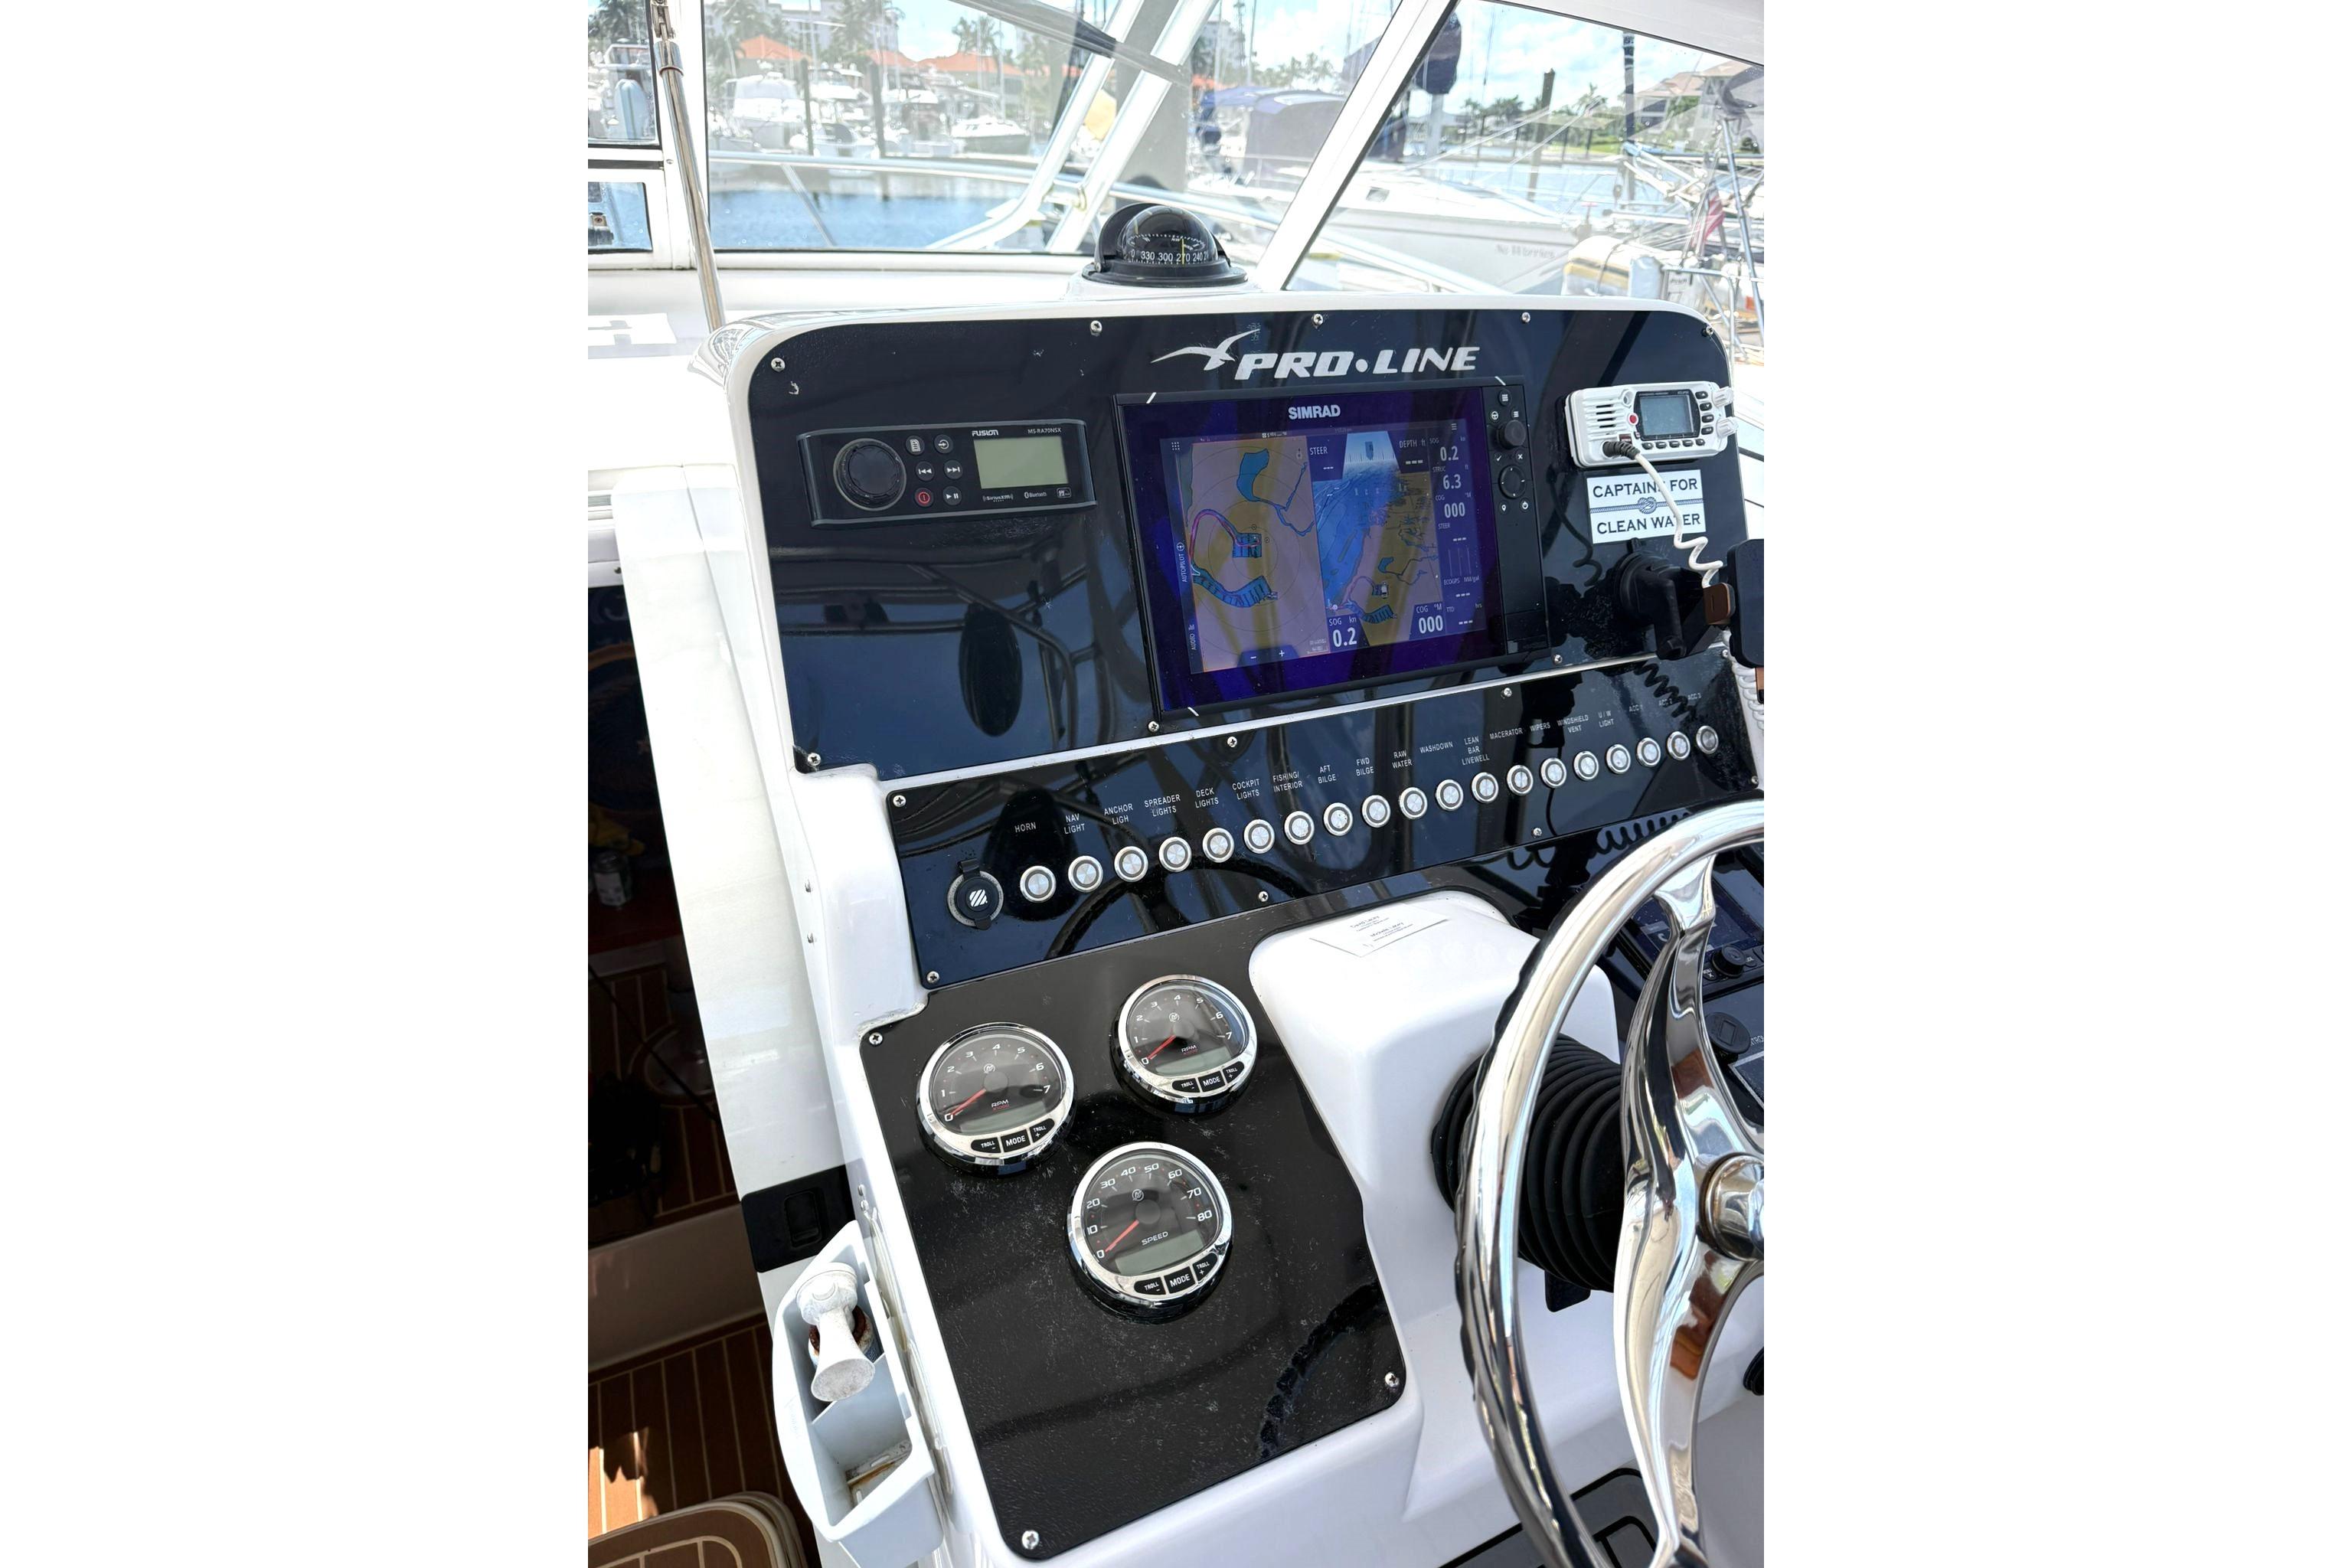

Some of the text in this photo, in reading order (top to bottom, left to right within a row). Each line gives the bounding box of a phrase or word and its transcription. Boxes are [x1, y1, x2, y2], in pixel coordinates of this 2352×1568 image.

[1141, 251, 1155, 260] 330
[1158, 253, 1173, 261] 300
[1193, 252, 1203, 262] 240
[1288, 404, 1341, 420] SIMRAD
[1399, 439, 1417, 448] DEPTH
[1310, 447, 1328, 456] STEER
[1440, 446, 1459, 461] 0.2
[1443, 474, 1462, 489] 6.3
[1593, 479, 1697, 498] CAPTAIN FOR
[1444, 502, 1465, 518] 000
[1597, 513, 1700, 534] CLEAN WAER
[1179, 554, 1187, 583] AUTOPILOT
[1416, 605, 1429, 613] COG
[1329, 615, 1357, 626] SOG kn
[1419, 615, 1443, 634] 000
[1332, 627, 1357, 648] 0.2
[1557, 714, 1589, 727] WINDSHIELD
[1599, 718, 1614, 728] LIGHT
[1530, 722, 1550, 732] WIPERS
[1568, 725, 1582, 733] VENT
[1490, 727, 1523, 740] MACERATOR
[1464, 736, 1479, 746] LEAN
[1419, 741, 1453, 754] WASHDOWN
[1468, 746, 1480, 754] BAR
[1393, 750, 1407, 759] RAW
[1462, 753, 1490, 766] LIVEWELL
[1356, 757, 1370, 766] FWD
[1392, 759, 1412, 769] WATER
[1319, 765, 1331, 773] AFT
[1356, 766, 1374, 776] BILGE
[1272, 771, 1299, 782] FISHING/
[1318, 774, 1336, 784] BILGE
[1232, 779, 1260, 791] COCKPIT
[1273, 780, 1303, 792] INTERIOR
[1196, 787, 1214, 798] DECK
[1236, 789, 1260, 800] LIGHTS
[1144, 794, 1181, 808] SPREADER
[1195, 797, 1219, 808] LIGHTS
[1104, 803, 1133, 815] ANCHOR
[1152, 805, 1177, 817] LIGHTS
[1065, 813, 1080, 823] NAV
[1014, 822, 1037, 833] HORN
[1063, 823, 1086, 835] LIGHT
[1226, 1031, 1233, 1040] 7
[1181, 1044, 1197, 1054] RPM
[1203, 1076, 1221, 1087] MODE
[1043, 1085, 1051, 1094] 7
[991, 1099, 1009, 1108] RPM
[1005, 1135, 1026, 1147] MODE
[1121, 1166, 1136, 1177] 40
[1145, 1163, 1159, 1173] 50
[1168, 1169, 1183, 1180] 60
[1100, 1178, 1116, 1188] 30
[1187, 1187, 1202, 1199] 70
[1086, 1198, 1100, 1210] 20
[1197, 1210, 1213, 1222] 80
[1087, 1225, 1098, 1236] 10
[1142, 1231, 1168, 1246] SPEED
[1096, 1250, 1105, 1259] 0
[1196, 1261, 1210, 1269] TROLL
[1170, 1273, 1191, 1288] MODE
[1144, 1281, 1159, 1292] TROLL
